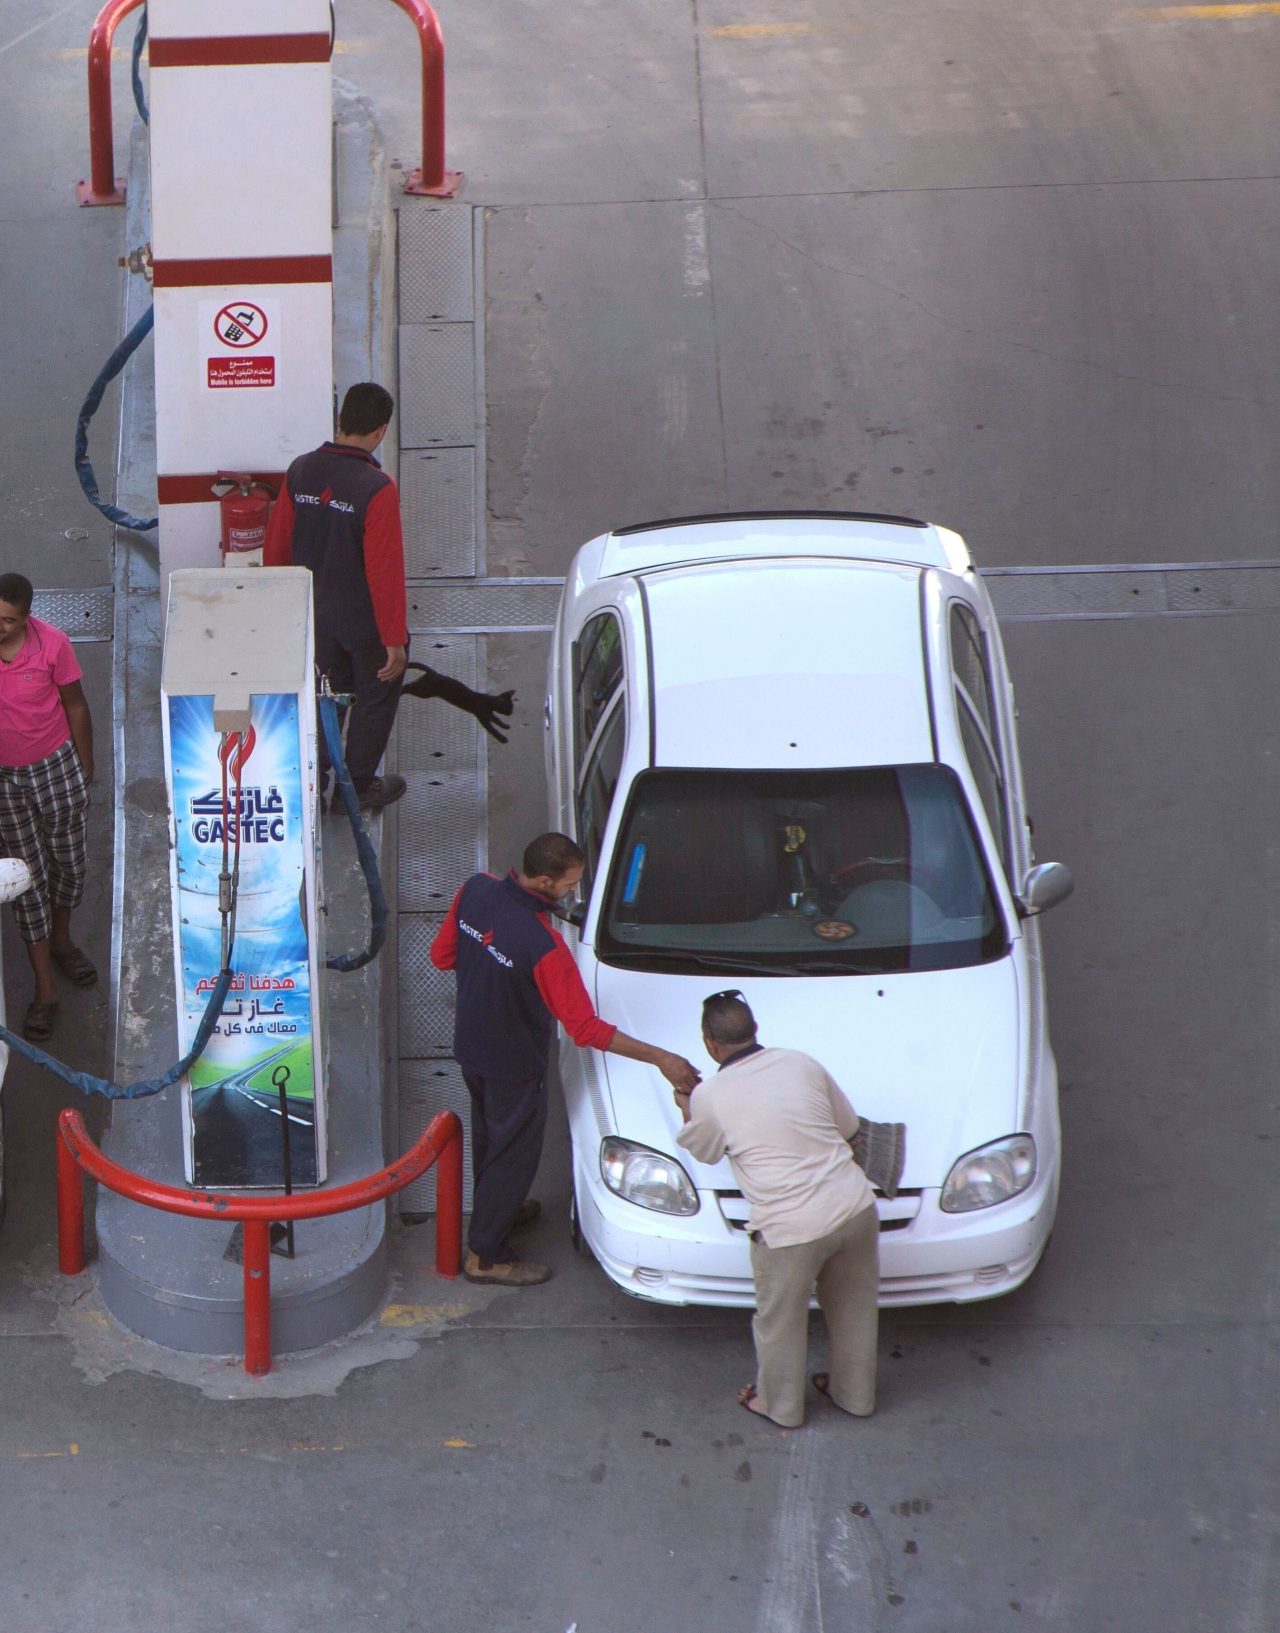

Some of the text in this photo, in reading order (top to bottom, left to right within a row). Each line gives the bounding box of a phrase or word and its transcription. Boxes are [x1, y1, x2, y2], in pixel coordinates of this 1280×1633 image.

[210, 378, 228, 386] Mobile
[229, 378, 234, 386] is
[260, 377, 272, 385] here
[193, 818, 285, 843] GASTEC
[195, 973, 295, 995] هدفنا ثقكم
[224, 1022, 241, 1036] كل
[268, 1022, 297, 1033] معاك
